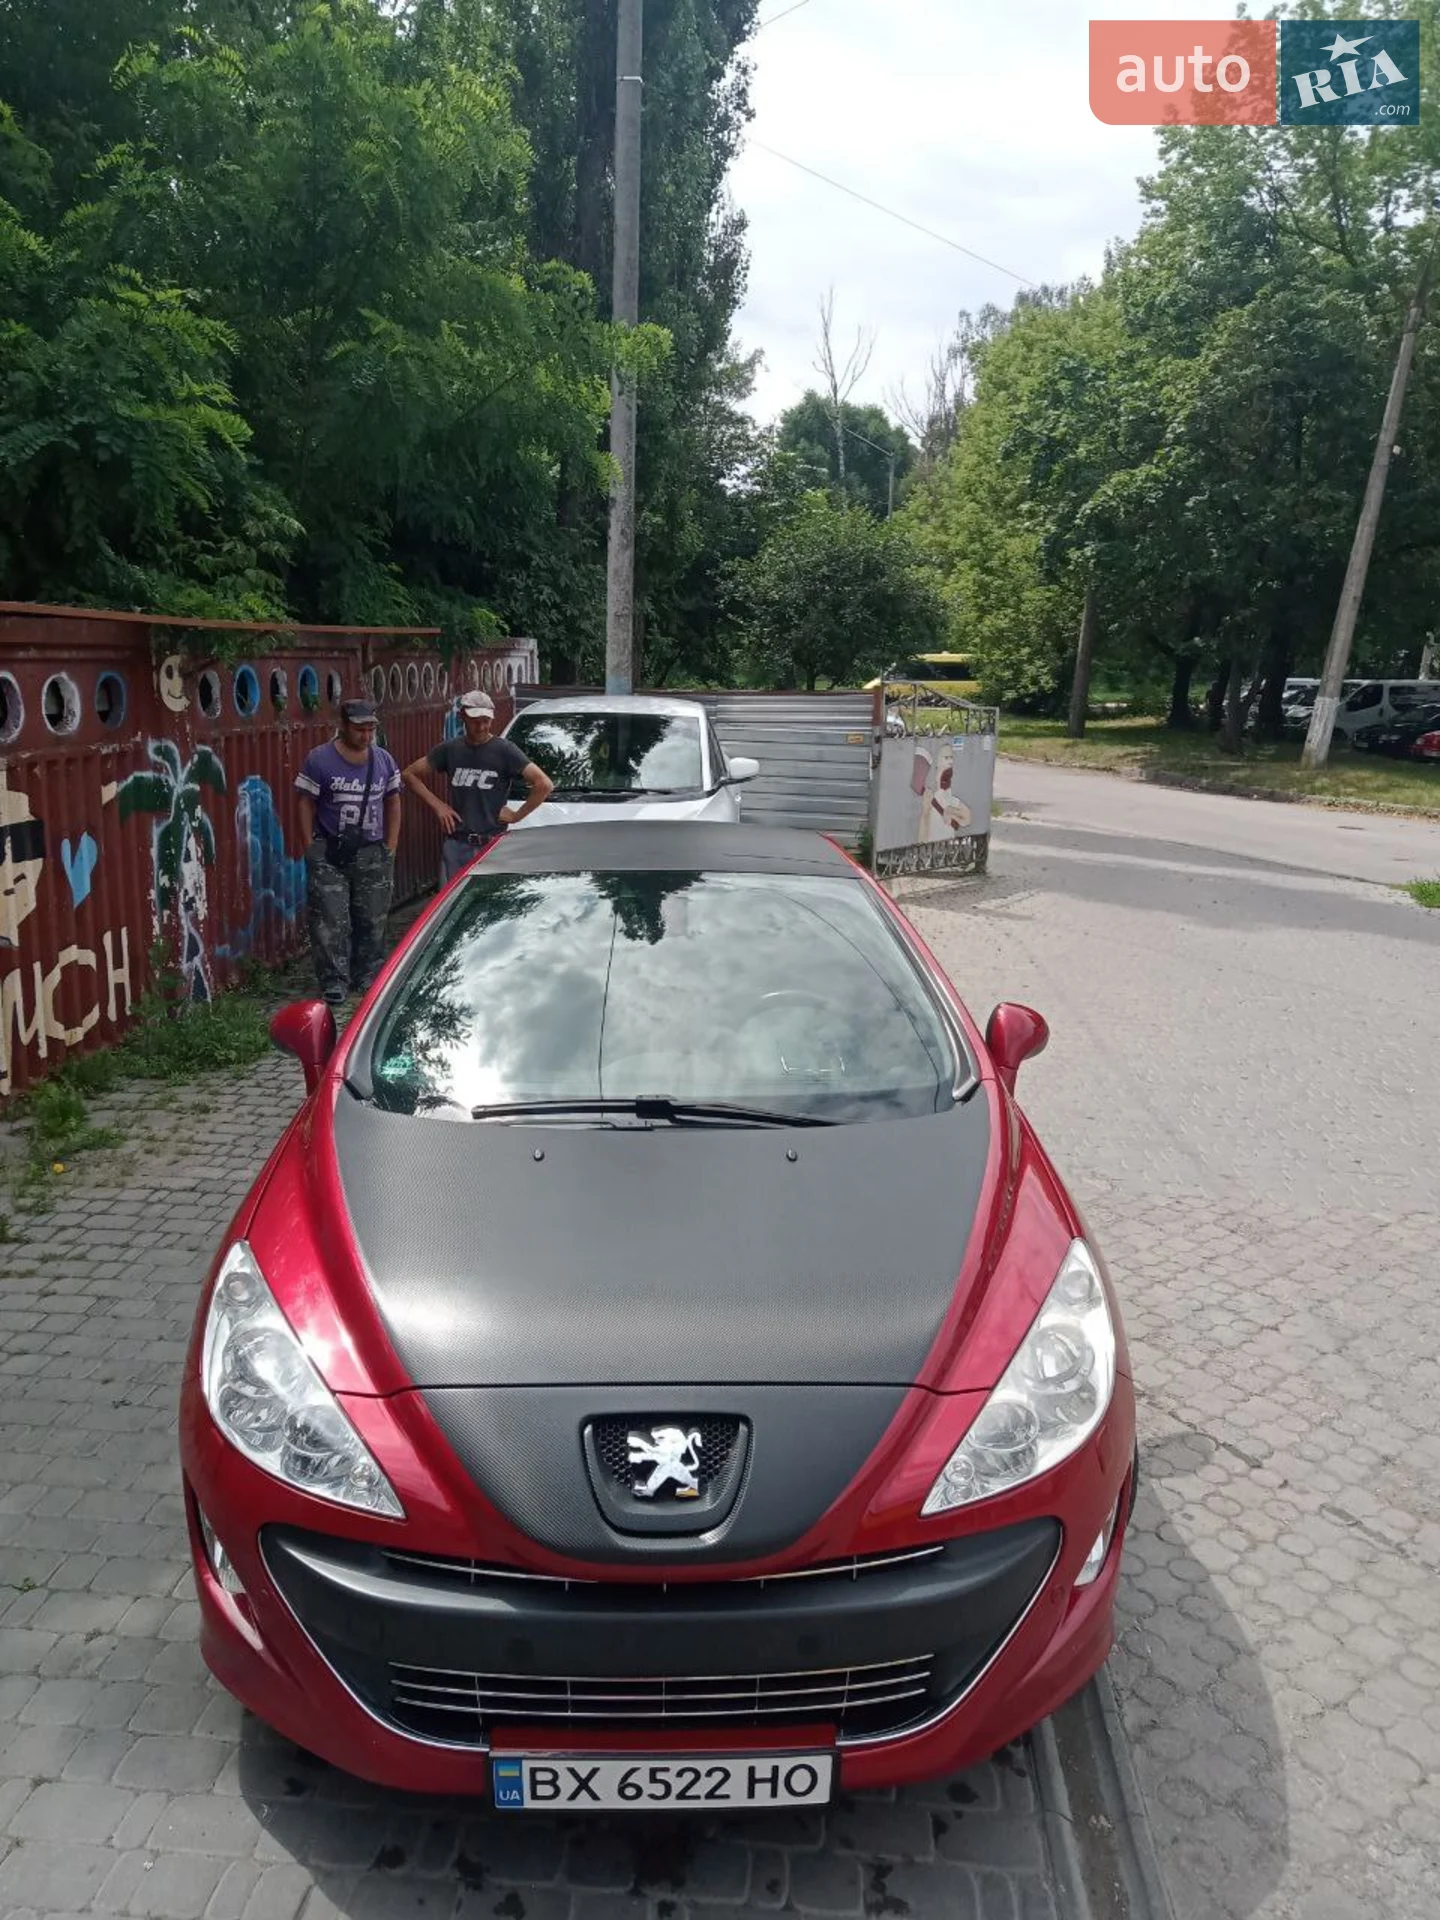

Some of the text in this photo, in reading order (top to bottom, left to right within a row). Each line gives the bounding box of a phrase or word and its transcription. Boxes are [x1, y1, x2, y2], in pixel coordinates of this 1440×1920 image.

[451, 767, 499, 790] UFC
[529, 1763, 818, 1801] BX 6522 HO
[499, 1789, 521, 1801] UA
